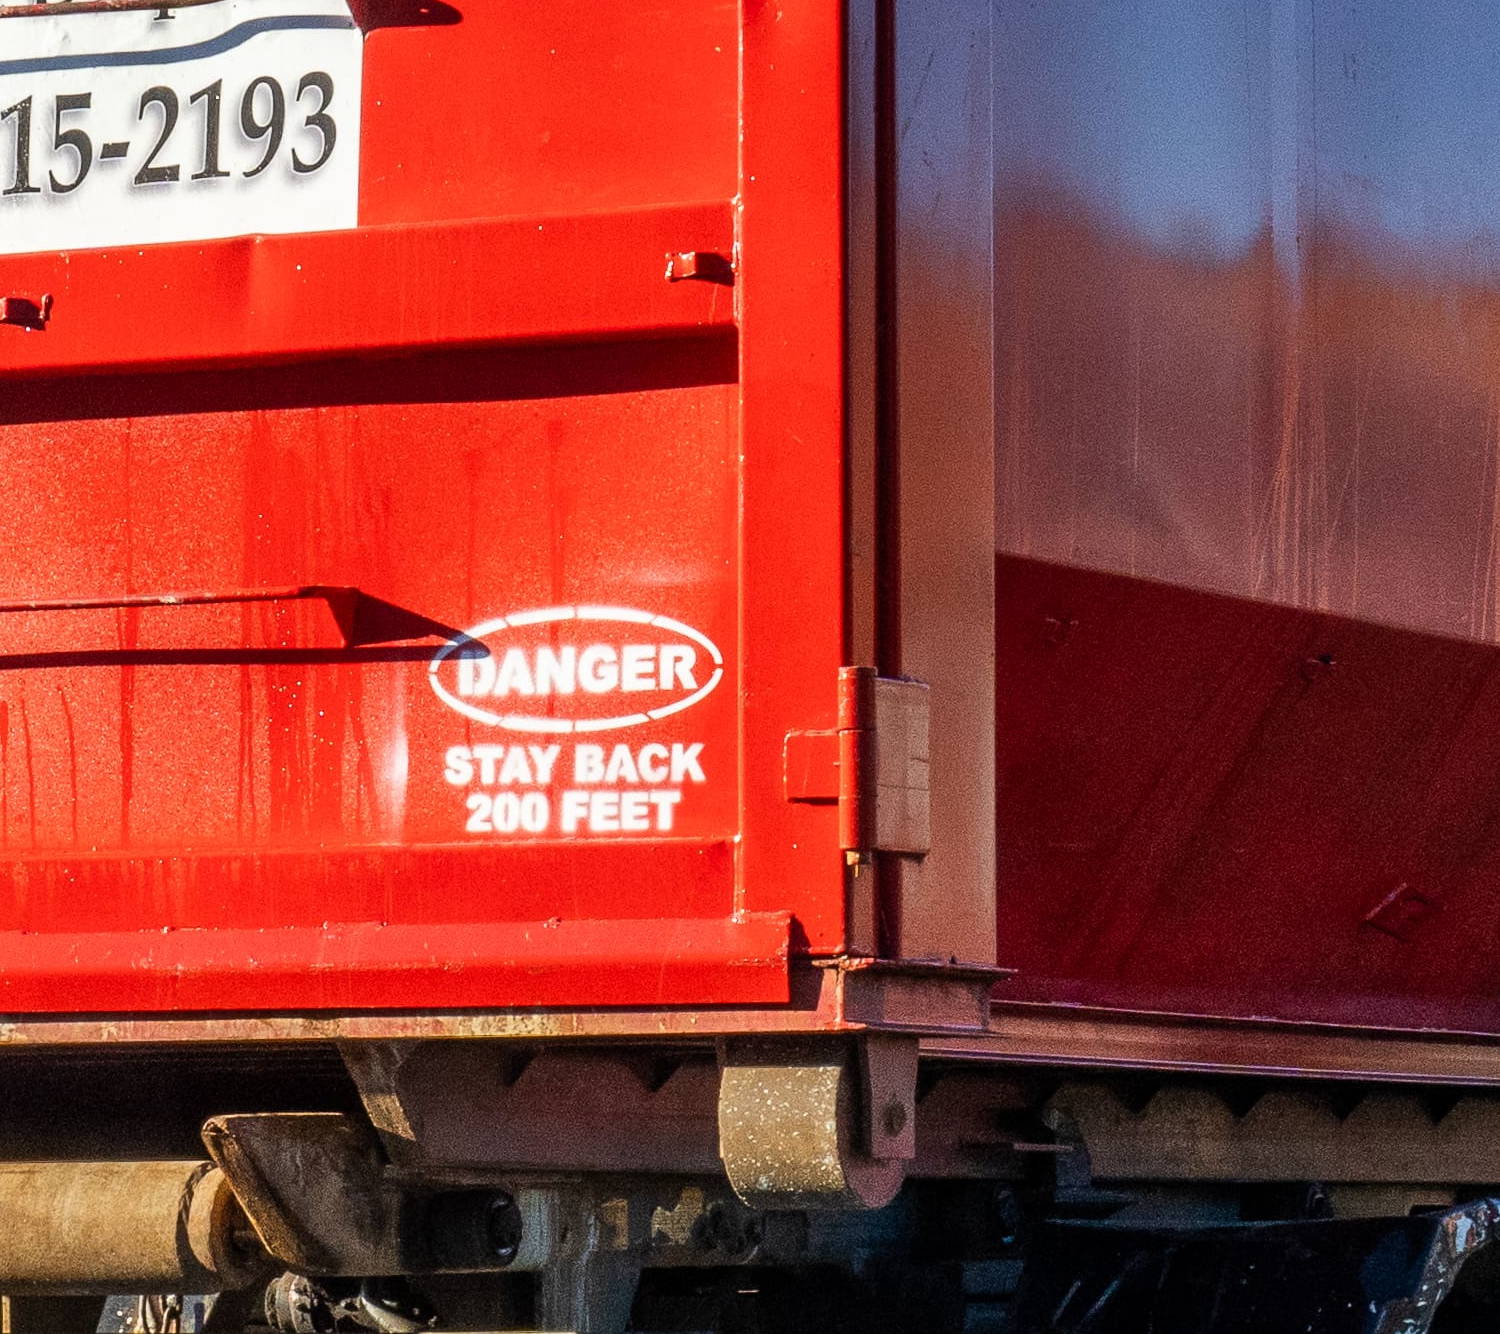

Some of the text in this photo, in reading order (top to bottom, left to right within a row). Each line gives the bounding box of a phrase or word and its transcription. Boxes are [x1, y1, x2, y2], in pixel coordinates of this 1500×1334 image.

[456, 643, 699, 697] DANGER
[443, 742, 707, 786] STAY BACK
[464, 788, 682, 833] 200 FEET
